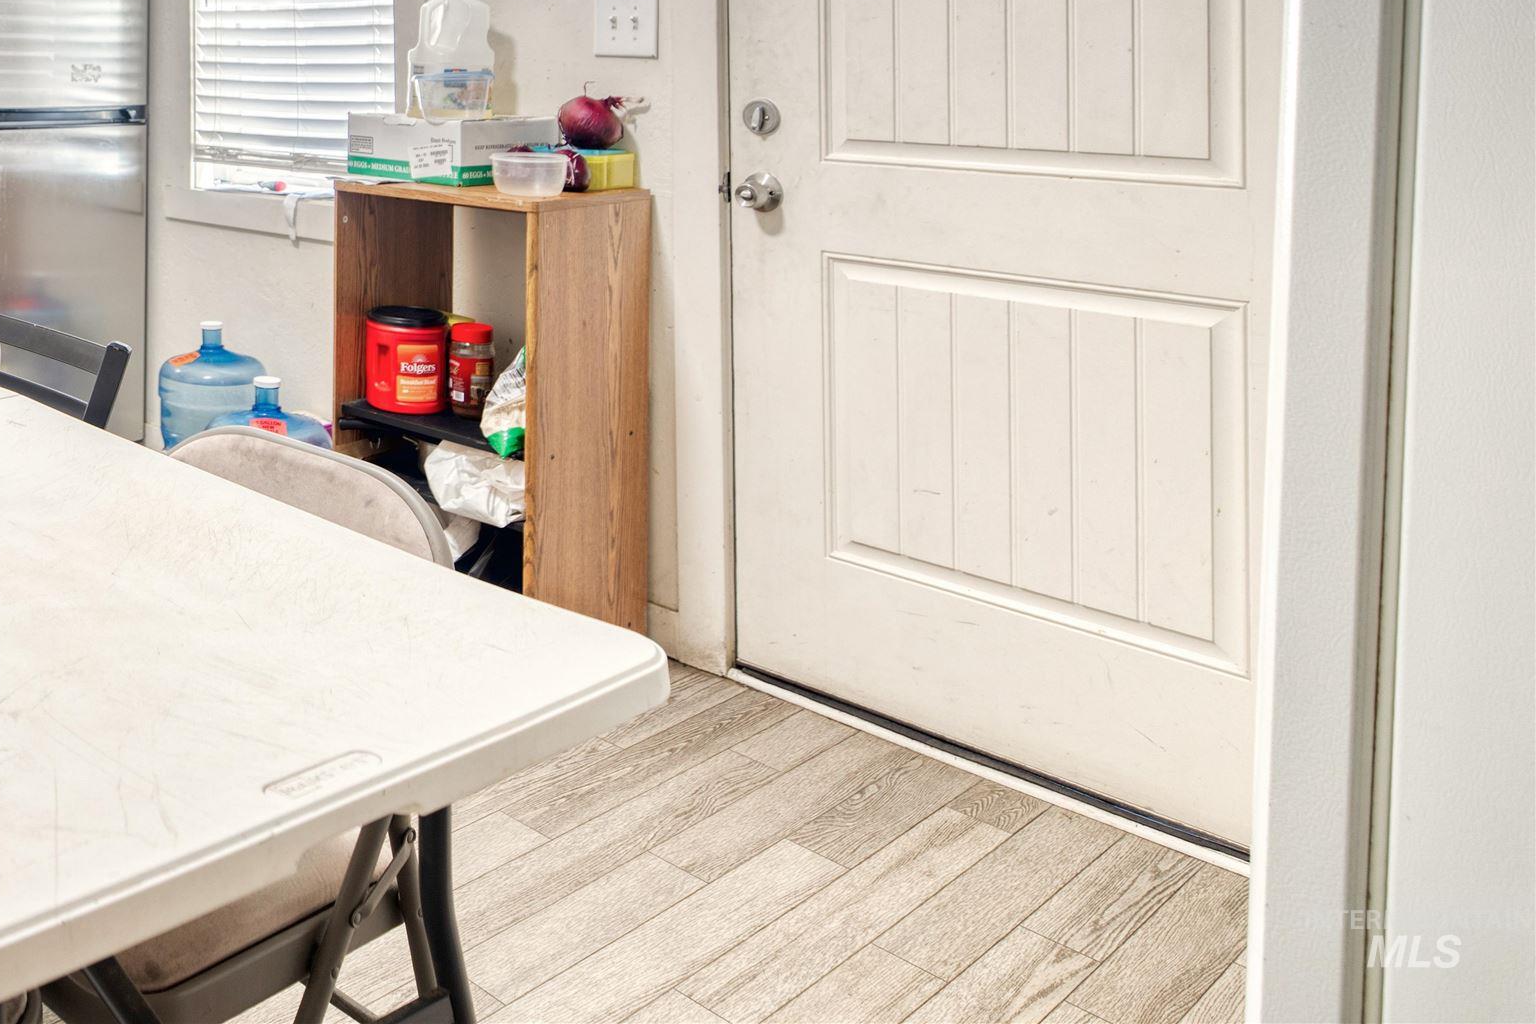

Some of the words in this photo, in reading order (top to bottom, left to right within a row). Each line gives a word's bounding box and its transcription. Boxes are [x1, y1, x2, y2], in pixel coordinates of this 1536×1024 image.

[353, 160, 368, 170] EGGS
[371, 162, 394, 173] MEDIUM
[470, 170, 484, 179] EGGS
[400, 361, 436, 375] Folgers
